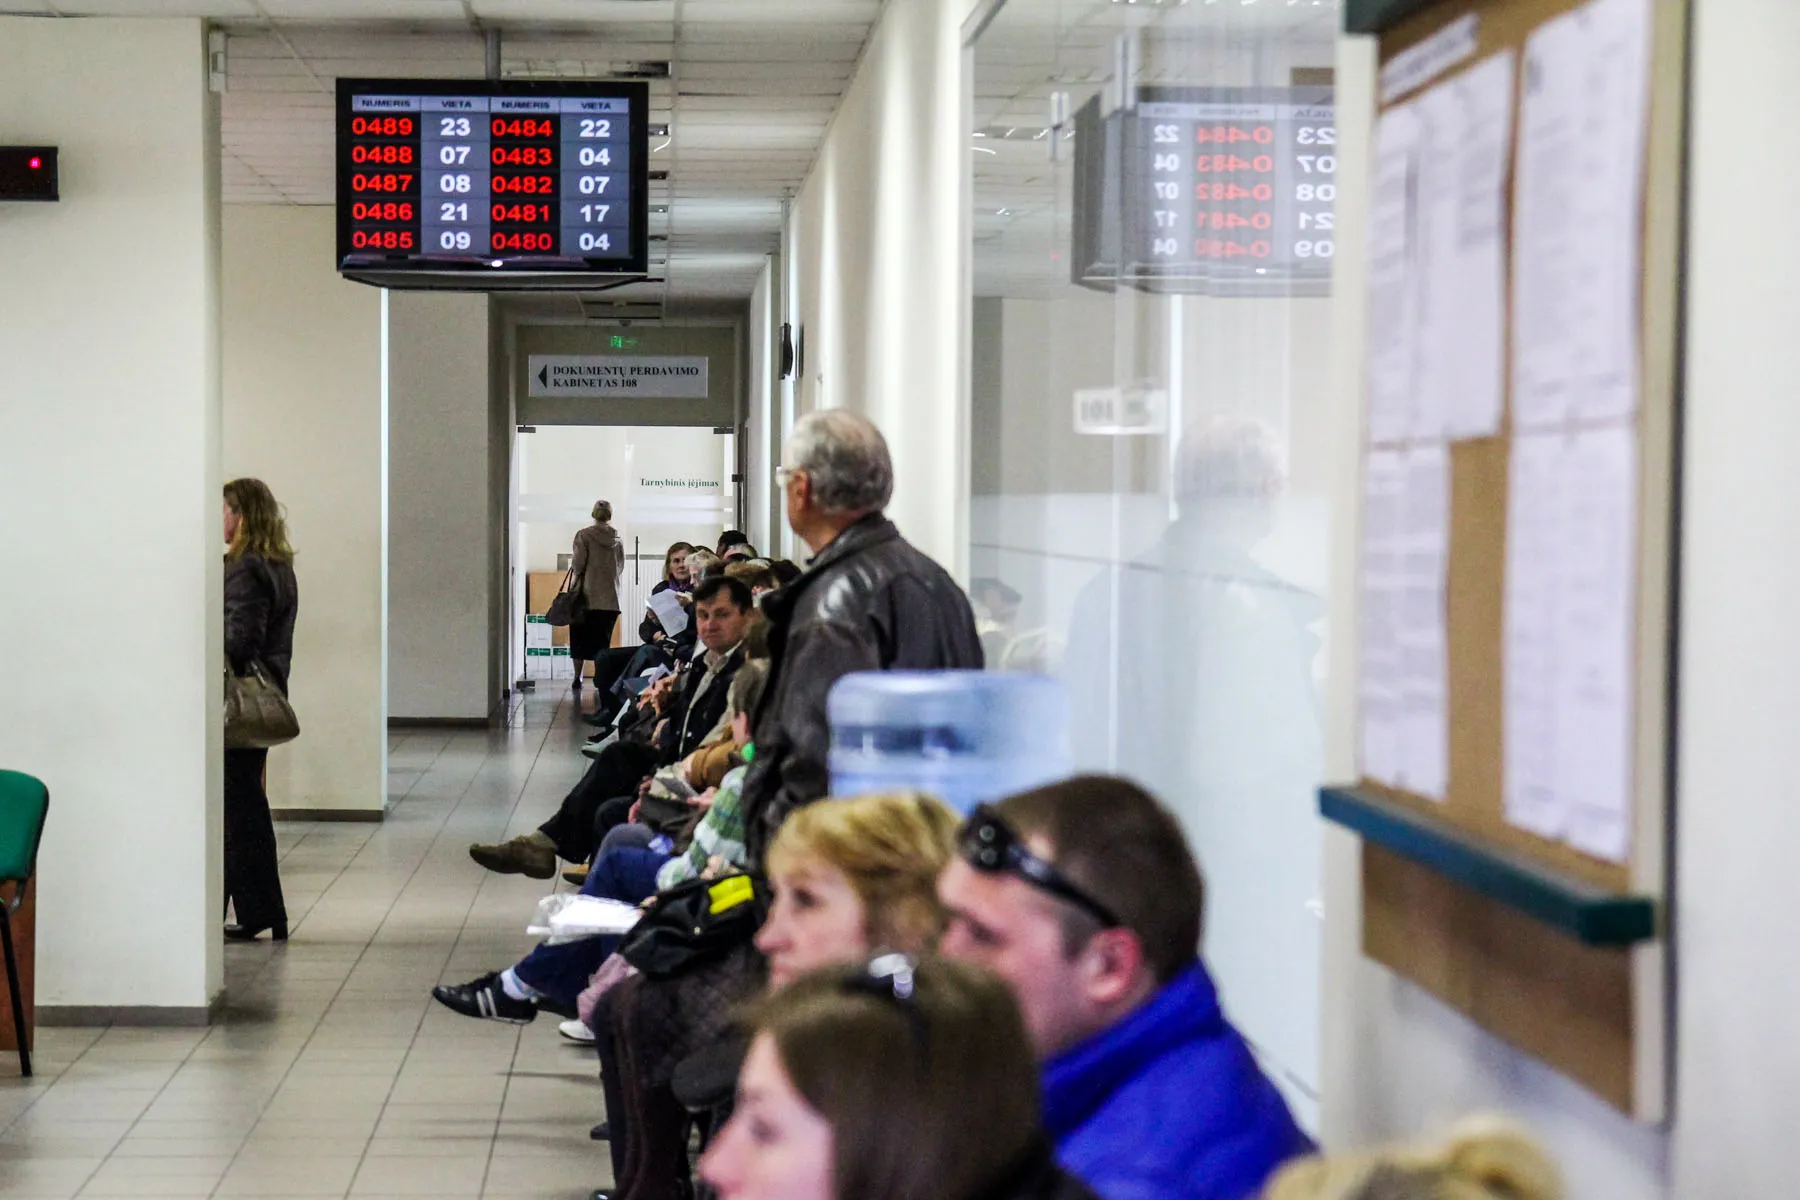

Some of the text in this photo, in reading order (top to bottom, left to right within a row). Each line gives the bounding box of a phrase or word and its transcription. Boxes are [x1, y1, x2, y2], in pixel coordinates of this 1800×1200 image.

[361, 99, 611, 110] NUMERIS VIETA NUMERIS VIETA
[352, 118, 610, 137] 0489 23 0484 22
[352, 146, 610, 165] 0488 07 0483 04
[352, 174, 610, 193] 0487 08 0482 07
[352, 203, 610, 221] 0486 21 0481 17
[352, 231, 610, 250] 0485 09 0480 04
[553, 366, 699, 377] DOKUMENTŲ PERDAVIMO
[553, 378, 638, 388] KABINETAS 108
[640, 478, 685, 488] Tarnybinis
